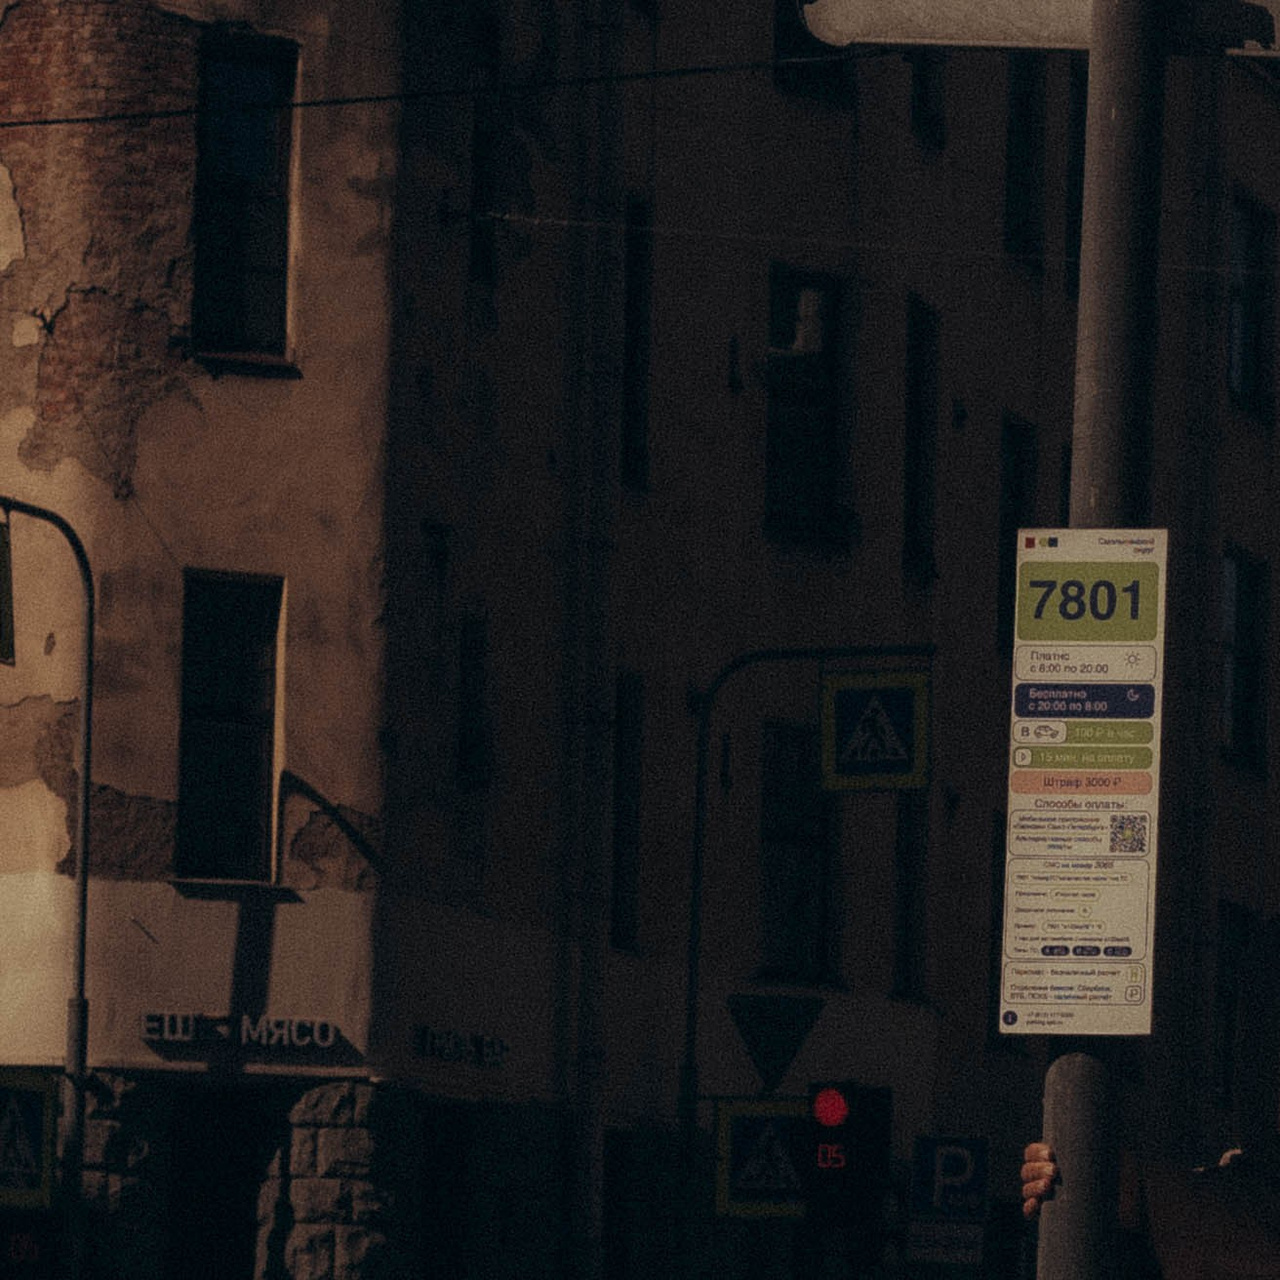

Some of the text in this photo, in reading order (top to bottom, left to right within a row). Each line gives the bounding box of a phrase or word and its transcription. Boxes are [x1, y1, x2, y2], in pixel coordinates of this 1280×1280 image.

[1029, 579, 1140, 621] 7801
[1030, 651, 1070, 661] Платно
[1064, 665, 1078, 673] по
[1029, 688, 1087, 700] Бесплатно
[1069, 703, 1082, 711] по
[1097, 754, 1135, 764] оплату
[1044, 776, 1082, 789] Штраф
[1034, 798, 1083, 809] Способы
[240, 1013, 336, 1048] МЯСО
